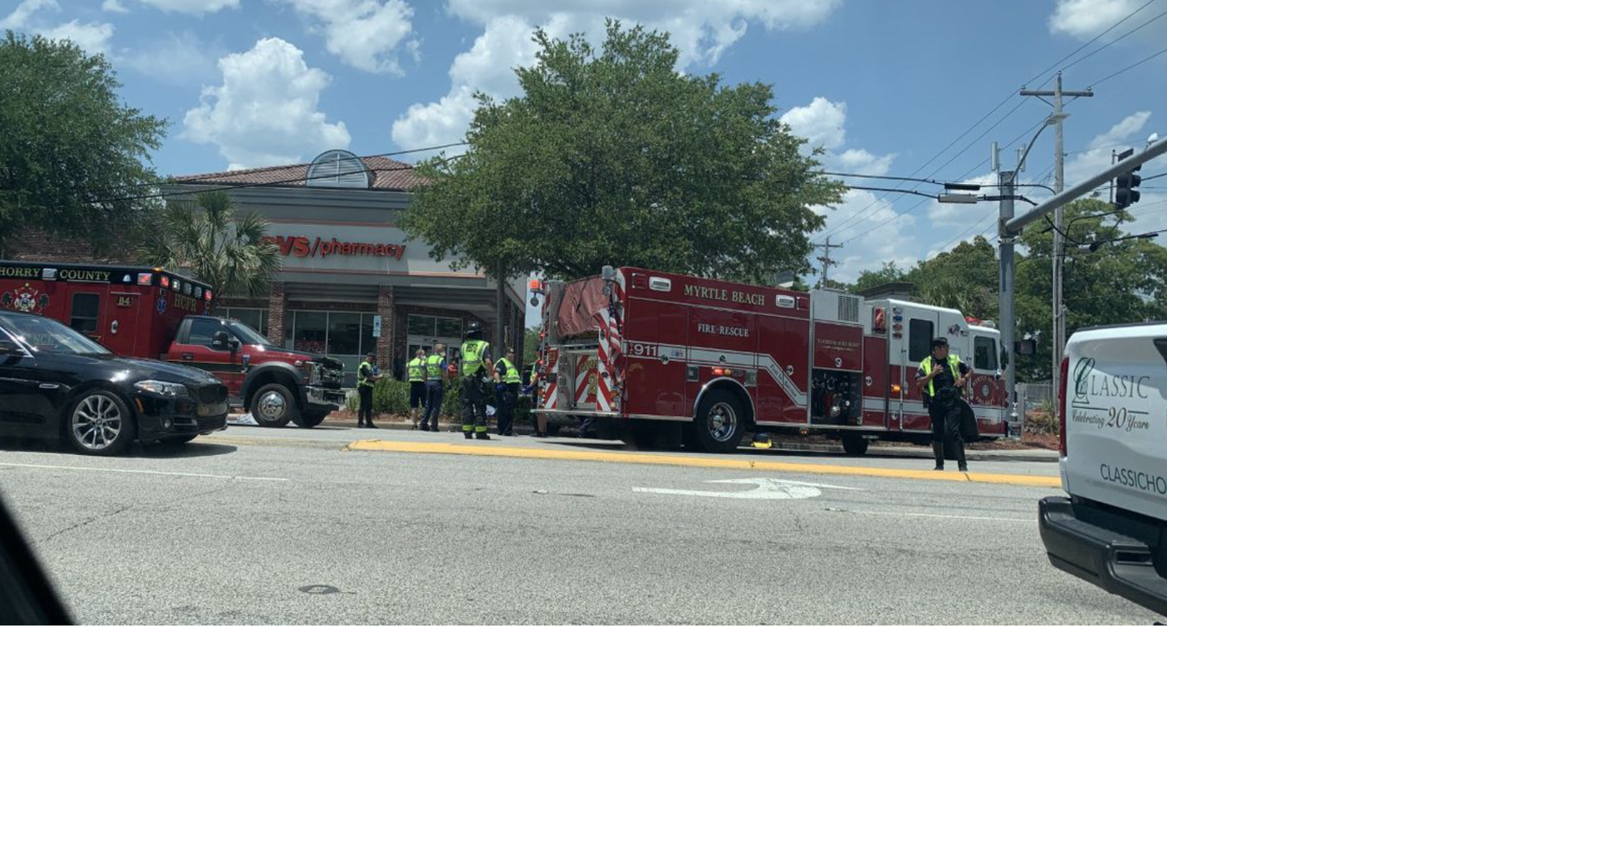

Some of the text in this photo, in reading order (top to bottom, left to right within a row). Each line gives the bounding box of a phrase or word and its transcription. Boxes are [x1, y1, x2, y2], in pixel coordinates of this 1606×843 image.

[0, 266, 111, 280] HORRY COUNTY
[173, 293, 197, 313] HCFR
[684, 284, 765, 306] MYRTLE BEACH
[697, 323, 750, 337] FIRE-RESCUE
[633, 343, 657, 357] 911
[835, 357, 842, 368] 9
[1073, 357, 1150, 399] CLASSIC
[1072, 406, 1149, 432] Celebrating 20 Years
[1099, 463, 1167, 495] CLASSICHO
